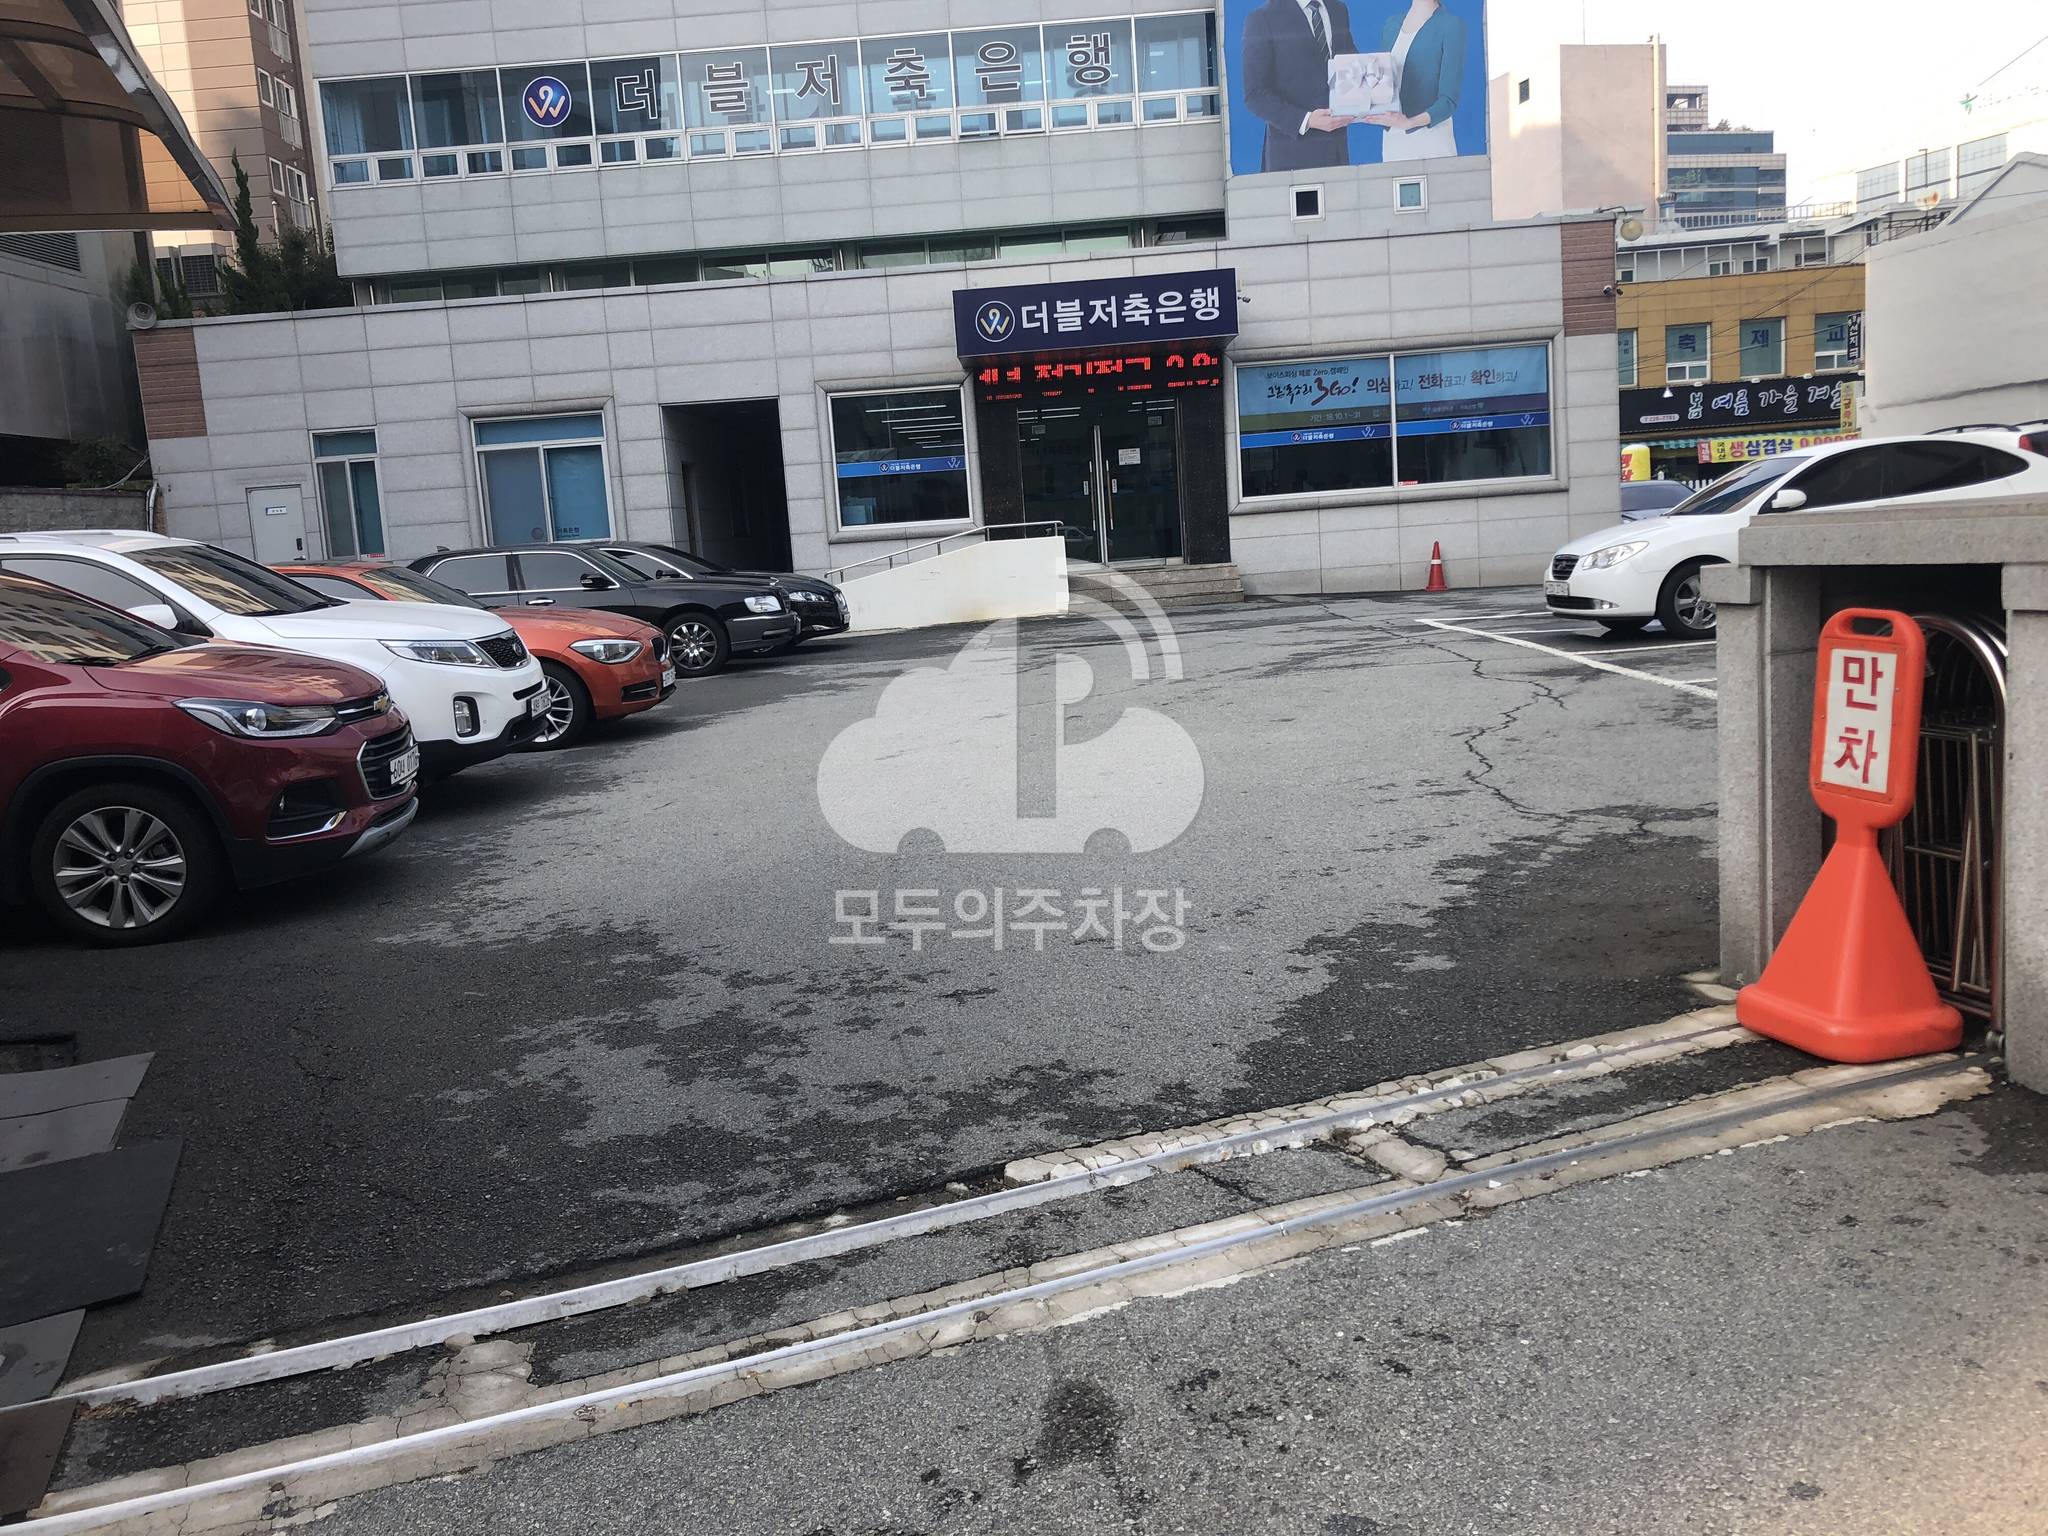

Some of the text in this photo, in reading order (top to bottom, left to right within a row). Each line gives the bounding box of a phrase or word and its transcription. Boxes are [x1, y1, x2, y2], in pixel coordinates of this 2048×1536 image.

[613, 32, 1112, 120] 더블저축은행
[1021, 286, 1220, 334] 더블저축은행
[1687, 391, 1704, 420] 봄
[1711, 389, 1750, 417] 여름
[1758, 385, 1798, 414] 가을
[1729, 438, 1794, 459] 생삼겹살
[1833, 656, 1884, 785] 만차
